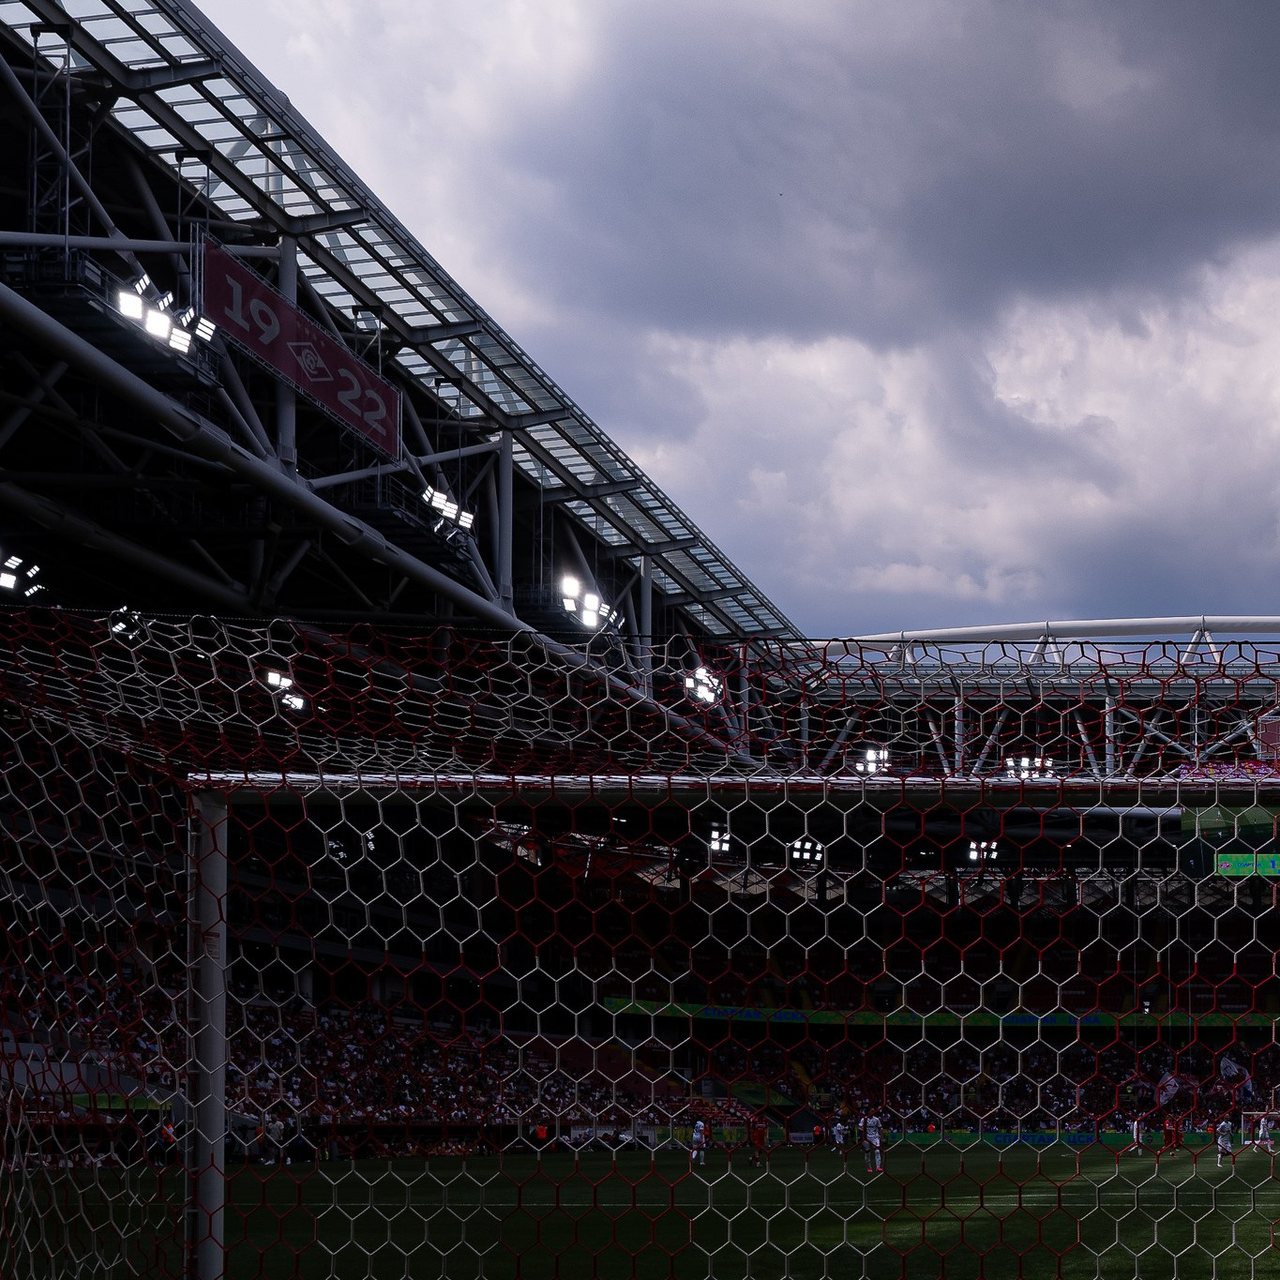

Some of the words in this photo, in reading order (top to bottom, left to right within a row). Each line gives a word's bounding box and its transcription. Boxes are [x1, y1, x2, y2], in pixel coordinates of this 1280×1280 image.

[224, 273, 281, 346] 19
[337, 367, 387, 437] 22
[1002, 1015, 1057, 1025] СПАРАК
[1066, 1134, 1102, 1145] ЦСК
